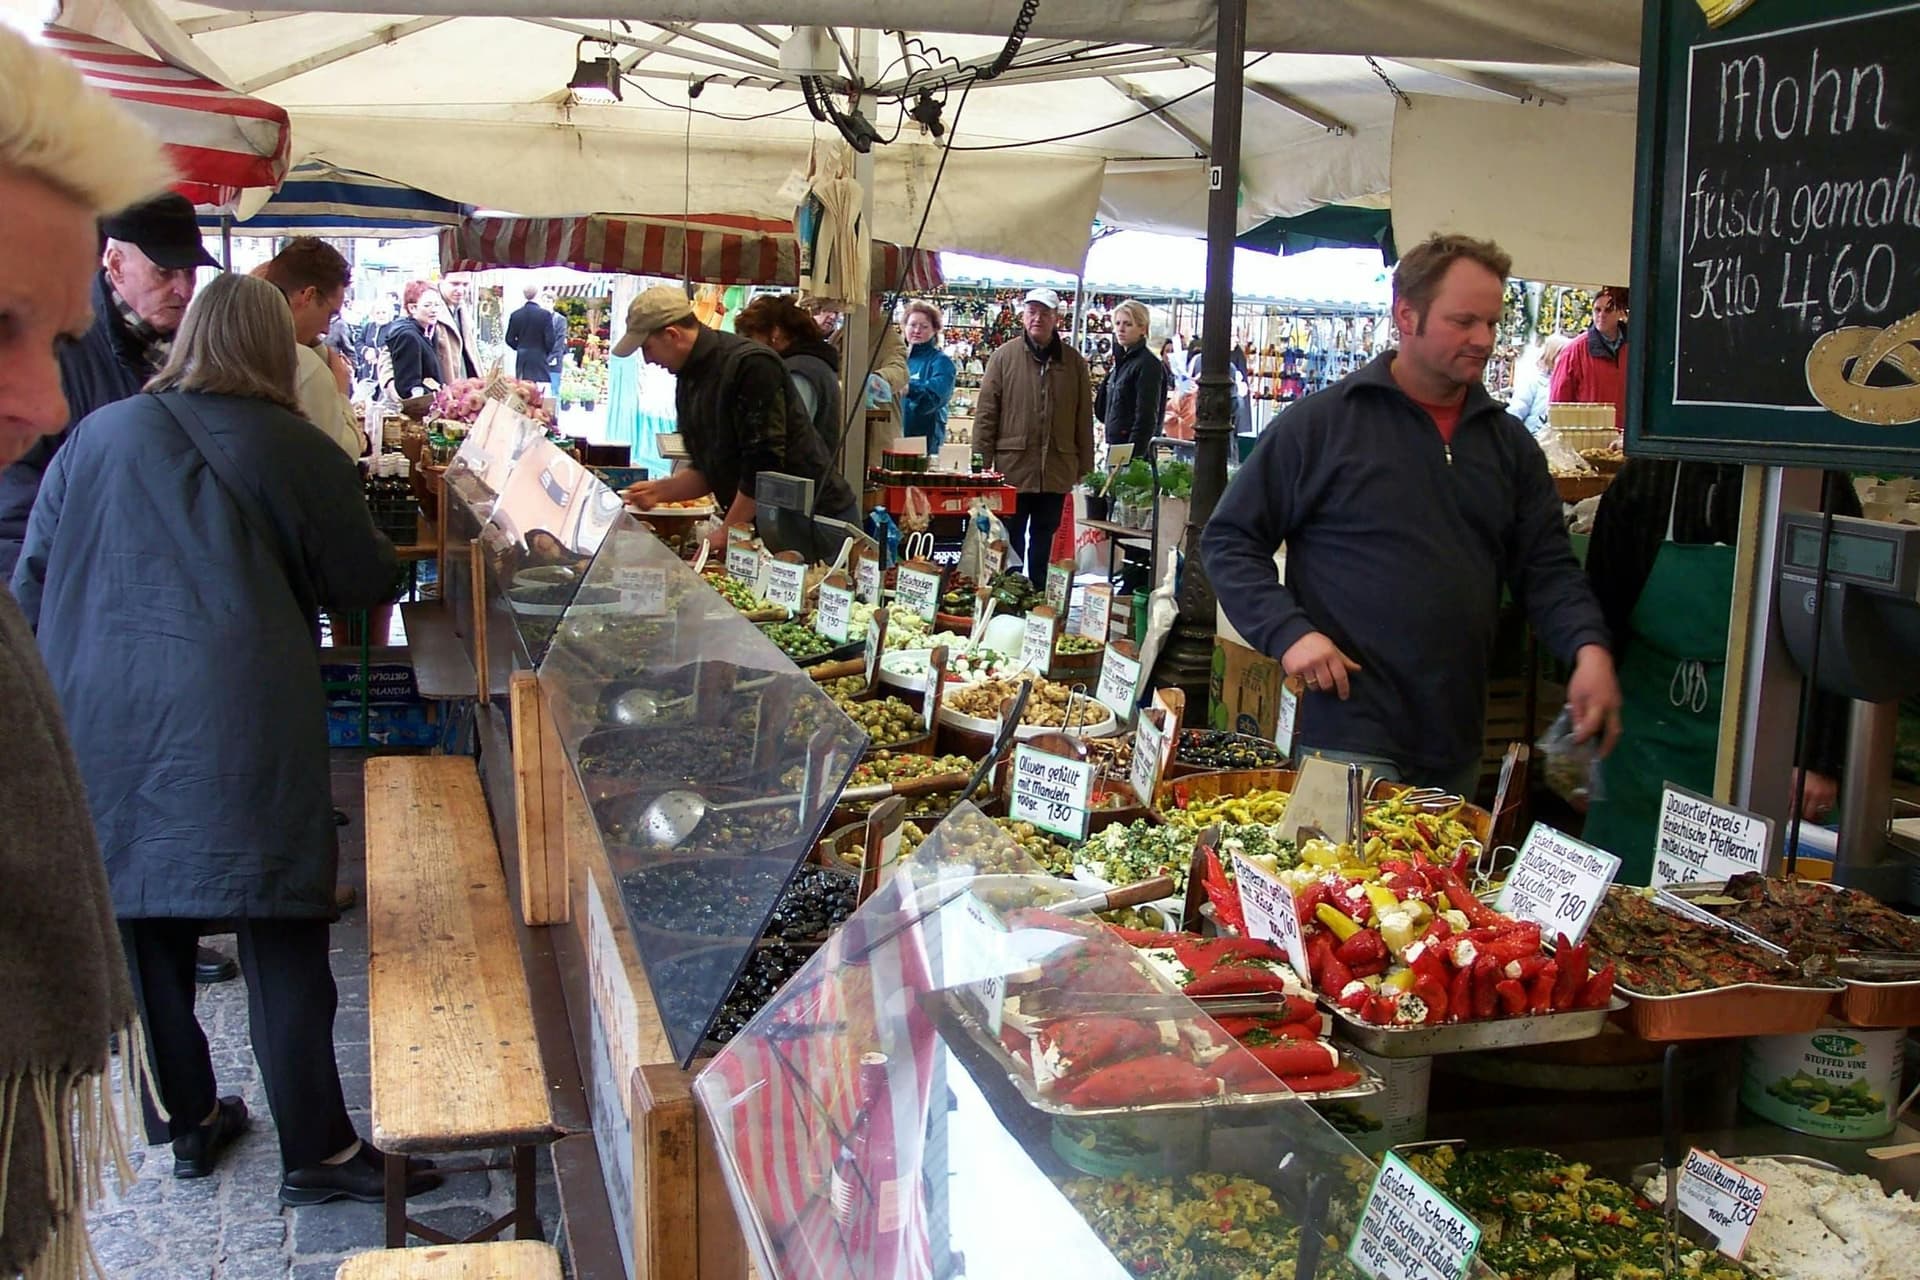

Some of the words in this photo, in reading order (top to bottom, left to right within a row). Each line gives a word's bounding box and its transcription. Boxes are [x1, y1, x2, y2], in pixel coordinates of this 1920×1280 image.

[1718, 48, 1889, 143] Mohn
[1689, 168, 1781, 253] frisch
[1690, 254, 1760, 320] Kilo
[1018, 777, 1031, 791] mit
[1032, 780, 1070, 803] Mandeln
[1019, 755, 1045, 777] Oliven
[1048, 765, 1080, 787] gefüllt
[1552, 843, 1567, 857] aus
[1566, 849, 1584, 865] dem
[1663, 815, 1707, 845] Griechische
[1709, 829, 1761, 864] Pfefferoni
[1511, 867, 1555, 903] Zucchini
[1523, 846, 1577, 886] Auberginen
[1804, 1053, 1844, 1068] STUFFED
[1848, 1060, 1867, 1070] VINE
[1816, 1067, 1854, 1080] LEAVES
[1685, 1151, 1736, 1194] Basilikum
[1735, 1176, 1762, 1206] Paste
[1370, 1193, 1389, 1215] mit
[1385, 1205, 1424, 1253] frischen
[1362, 1215, 1387, 1240] mild
[1380, 1234, 1423, 1278] gewürzt
